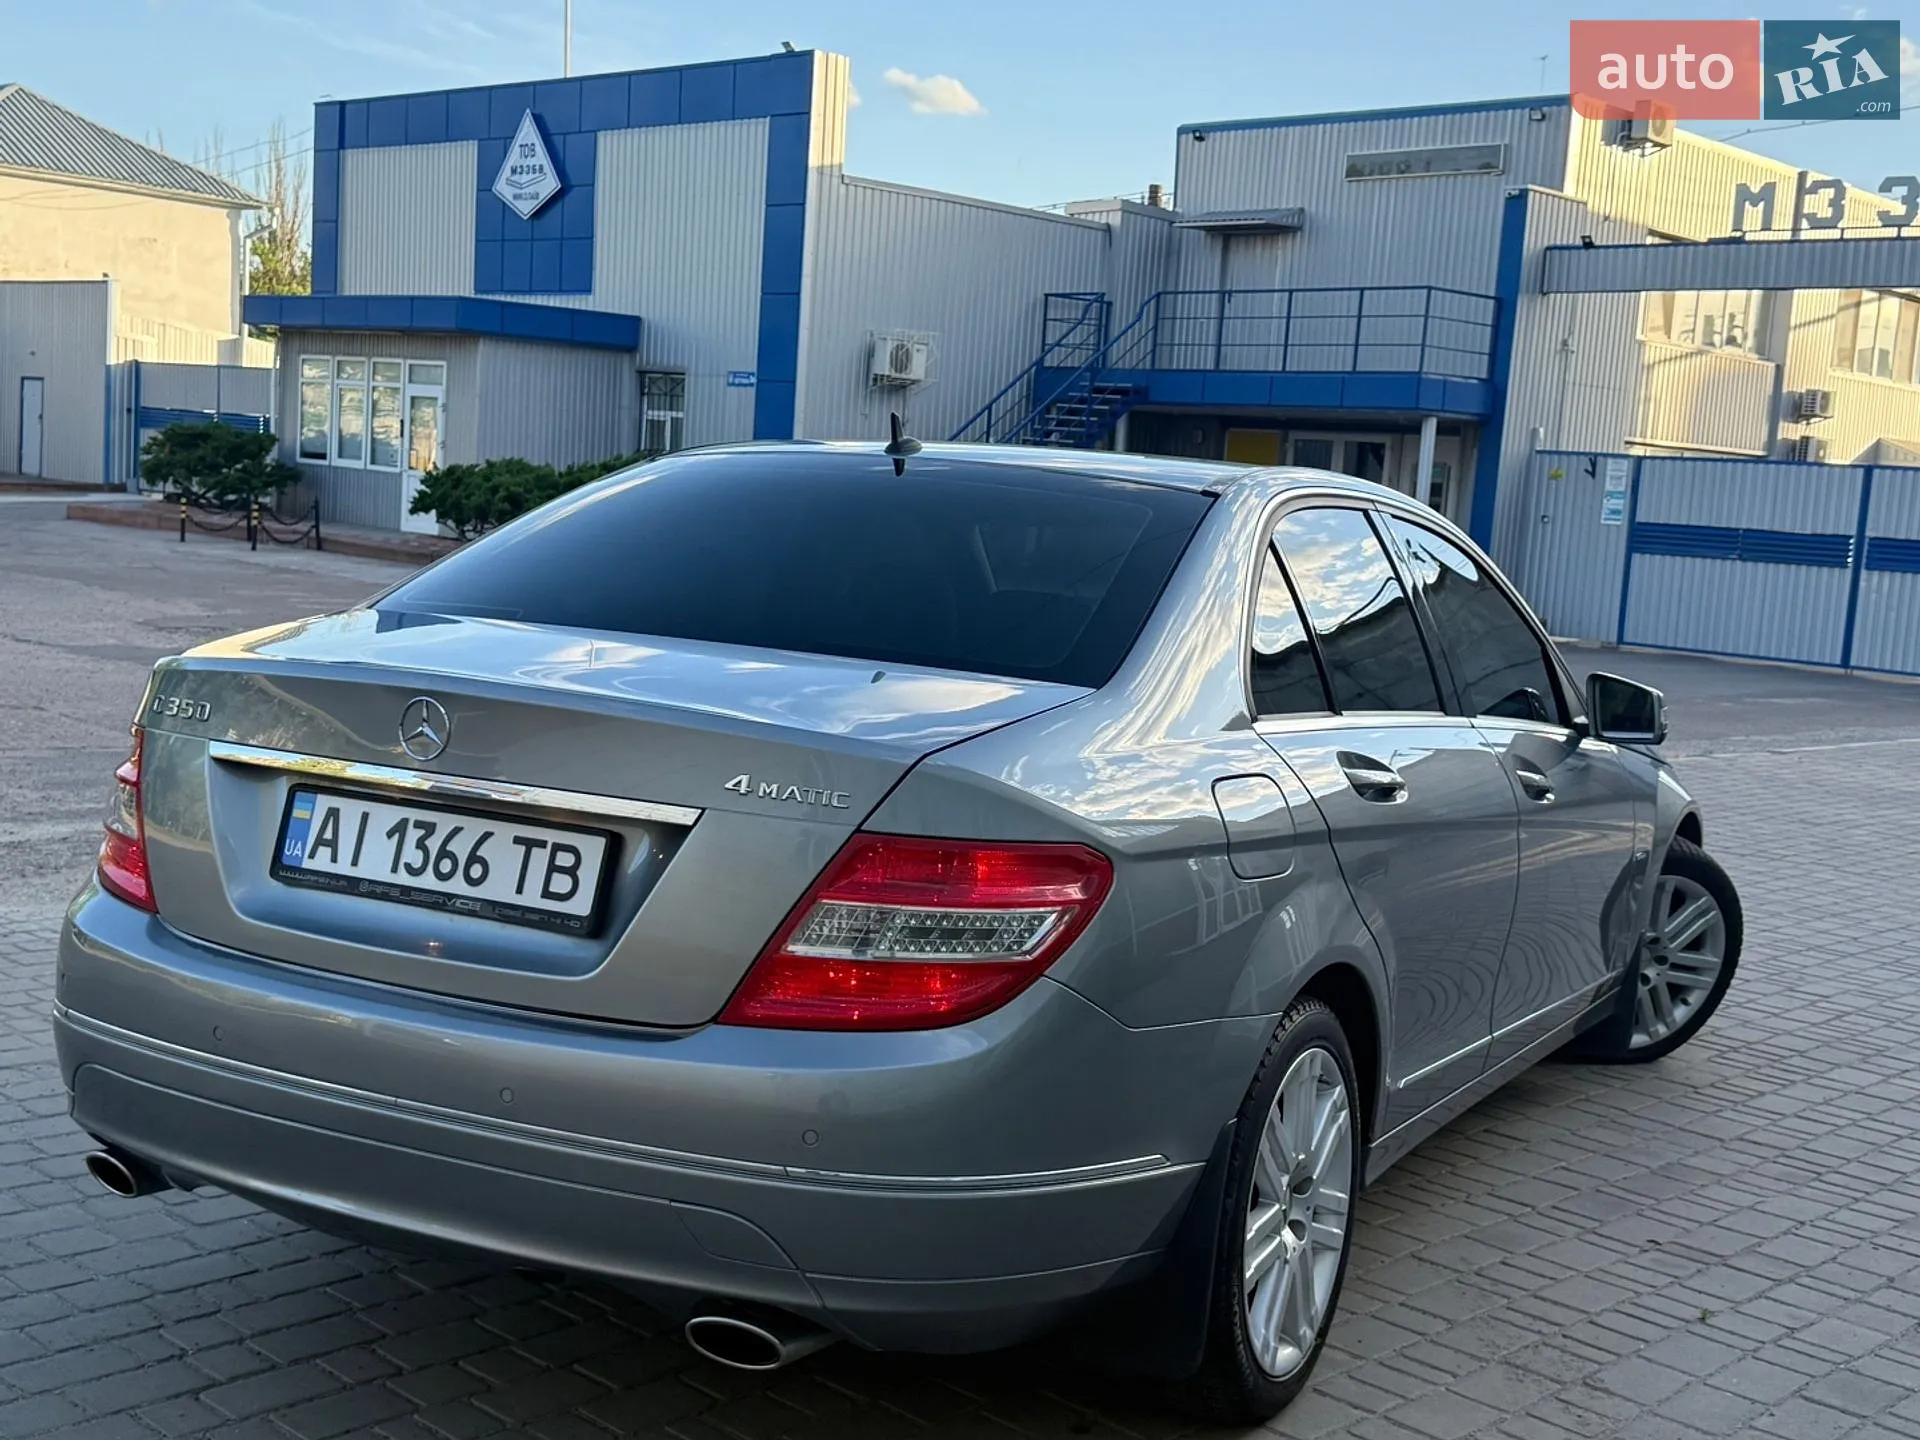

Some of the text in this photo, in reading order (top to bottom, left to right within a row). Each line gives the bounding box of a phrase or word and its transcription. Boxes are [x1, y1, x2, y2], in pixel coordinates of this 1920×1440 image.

[518, 142, 536, 159] ТОВ
[284, 838, 303, 858] UA
[308, 806, 582, 902] AI 1366 TB
